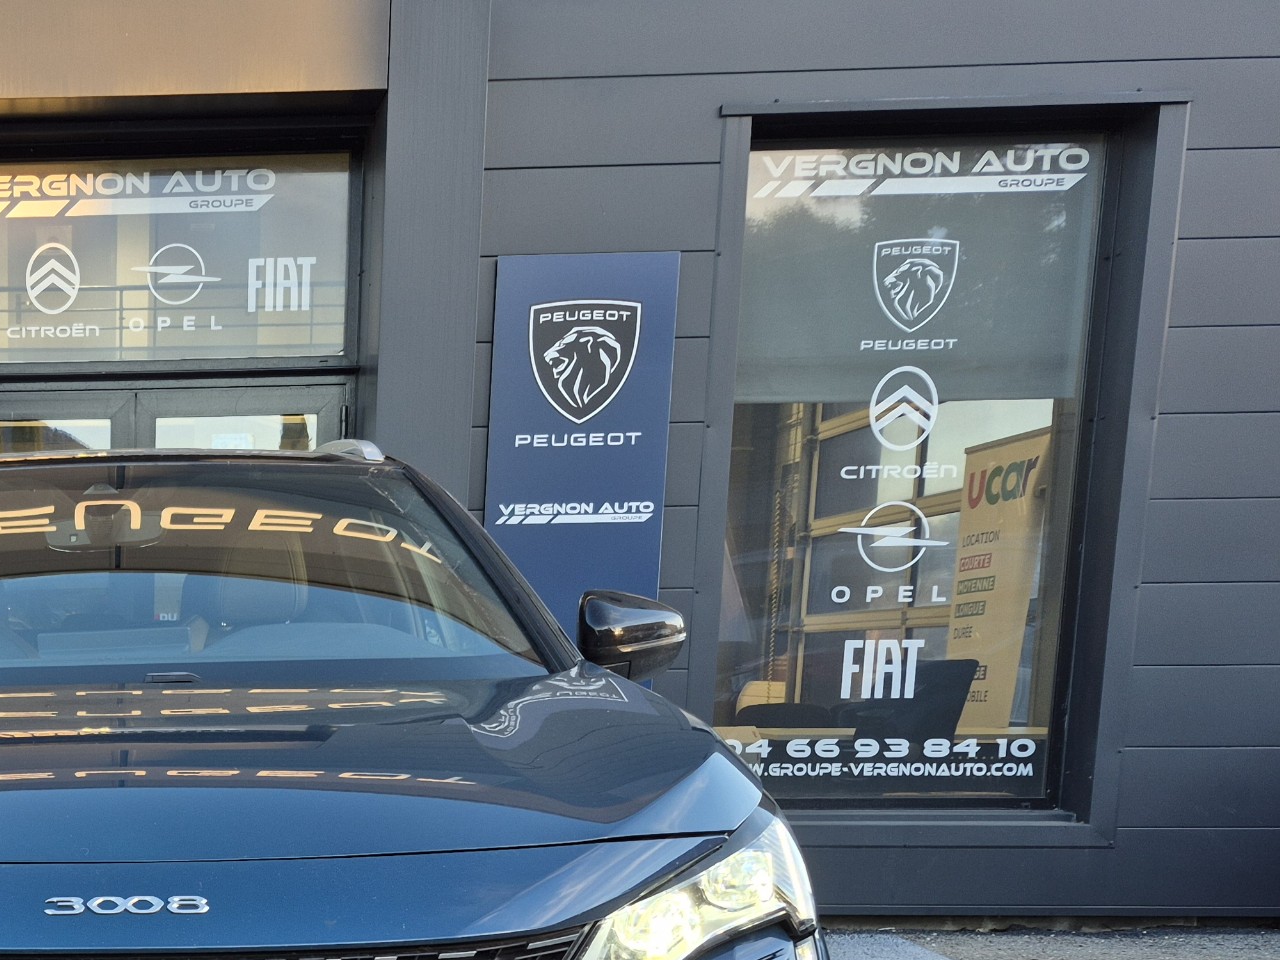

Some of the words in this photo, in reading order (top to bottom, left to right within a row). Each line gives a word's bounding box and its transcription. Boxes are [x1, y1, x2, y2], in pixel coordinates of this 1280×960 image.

[763, 151, 961, 177] VERGNON
[971, 147, 1090, 173] AUTO
[162, 168, 276, 194] AUTO
[998, 177, 1066, 188] GROUPE
[189, 198, 254, 210] GROUPE
[881, 245, 952, 257] PEUGEOT
[247, 257, 317, 312] FIAT
[129, 315, 222, 333] OPEL
[539, 310, 631, 324] PEUGEOT
[859, 338, 958, 351] PEUGEOT
[514, 432, 642, 447] PEUGEOT
[499, 502, 593, 515] VERGNON
[598, 501, 654, 514] AUTO
[831, 585, 947, 603] OPEL
[840, 640, 925, 699] FIAT
[786, 738, 840, 758] 66
[854, 738, 910, 758] 93
[923, 738, 981, 758] 84
[996, 738, 1036, 758] 10
[44, 895, 210, 915] 3008
